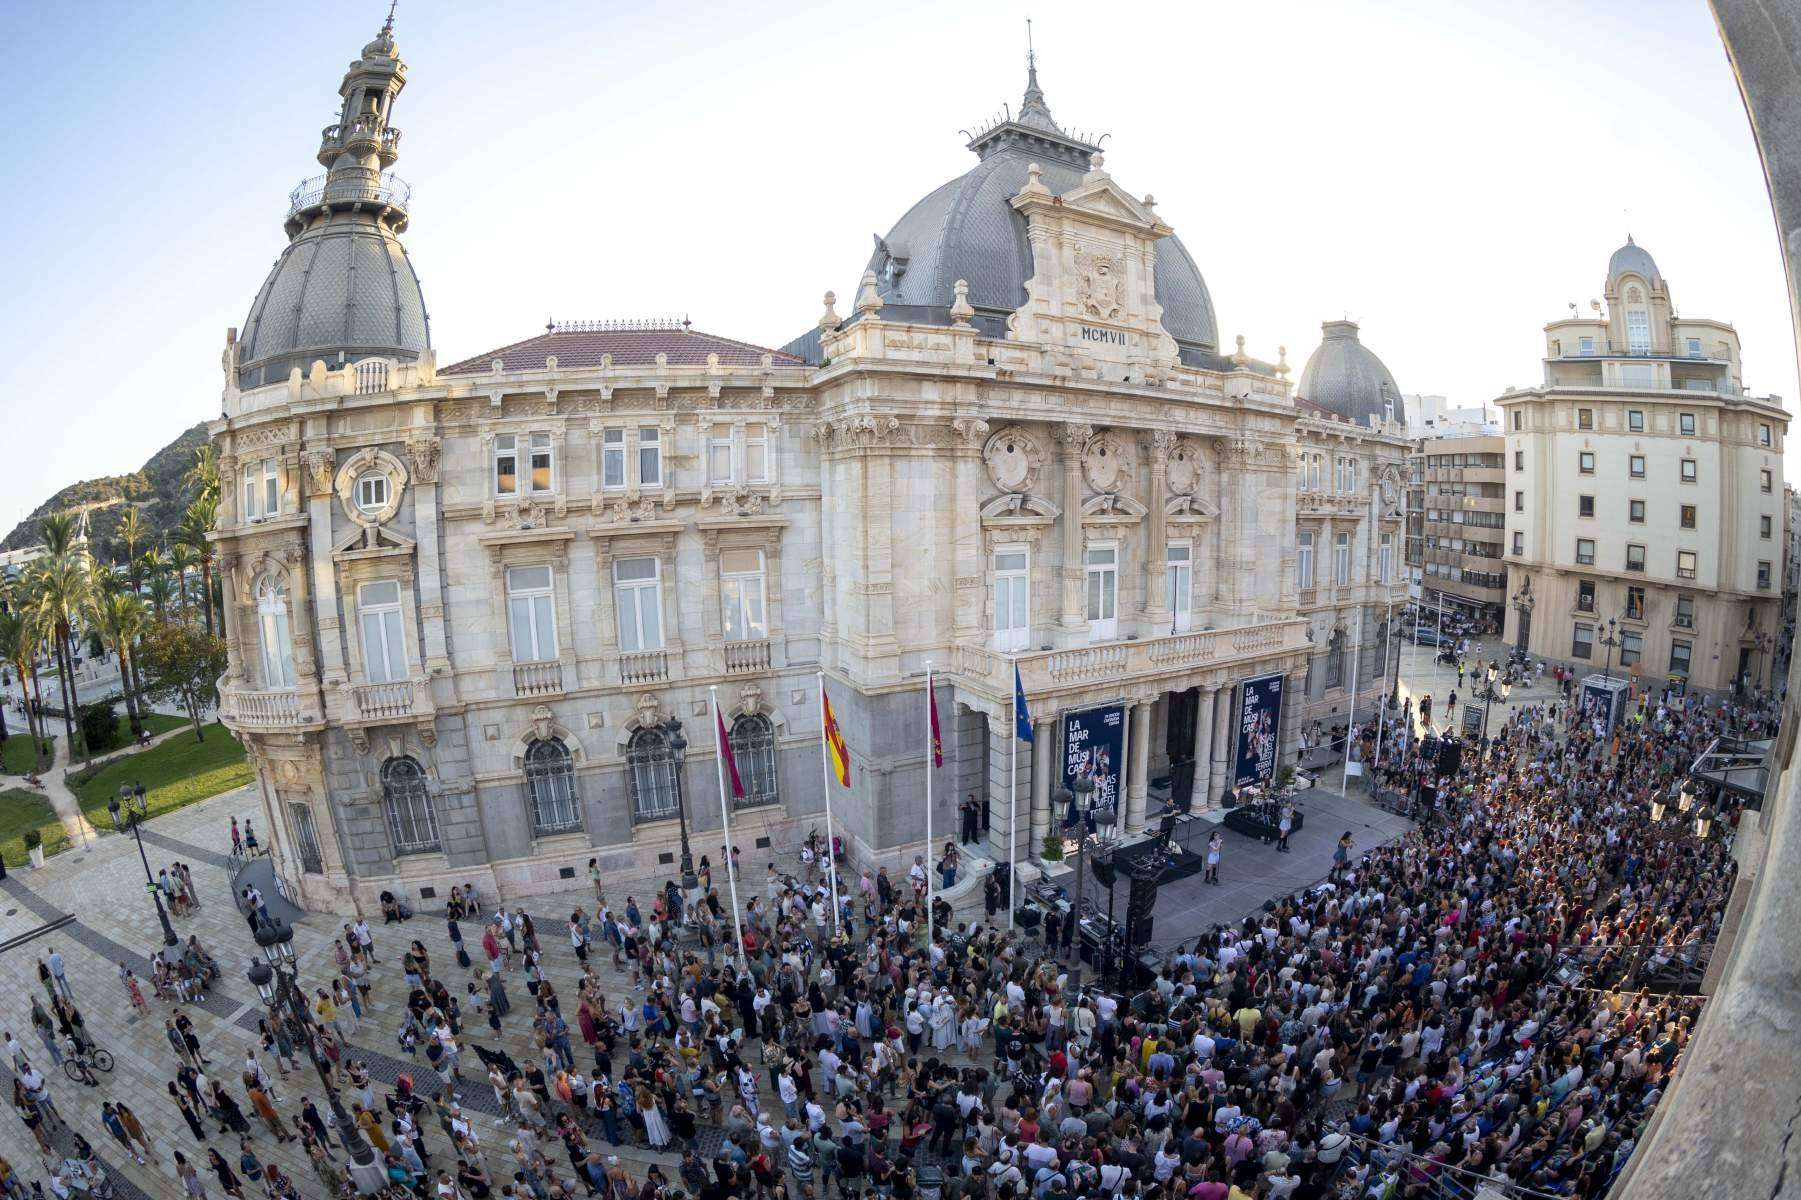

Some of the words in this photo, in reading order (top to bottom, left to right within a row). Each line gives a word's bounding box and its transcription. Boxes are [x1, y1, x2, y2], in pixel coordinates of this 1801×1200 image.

[1082, 327, 1125, 345] MCMVII
[1246, 686, 1254, 696] LA
[1245, 695, 1259, 706] MAR
[1244, 705, 1253, 715] DE
[1070, 720, 1080, 731] LA
[1069, 729, 1088, 742] MAR
[1069, 742, 1080, 753] DE
[1068, 750, 1089, 765] MÚSI
[1102, 785, 1116, 797] DEL
